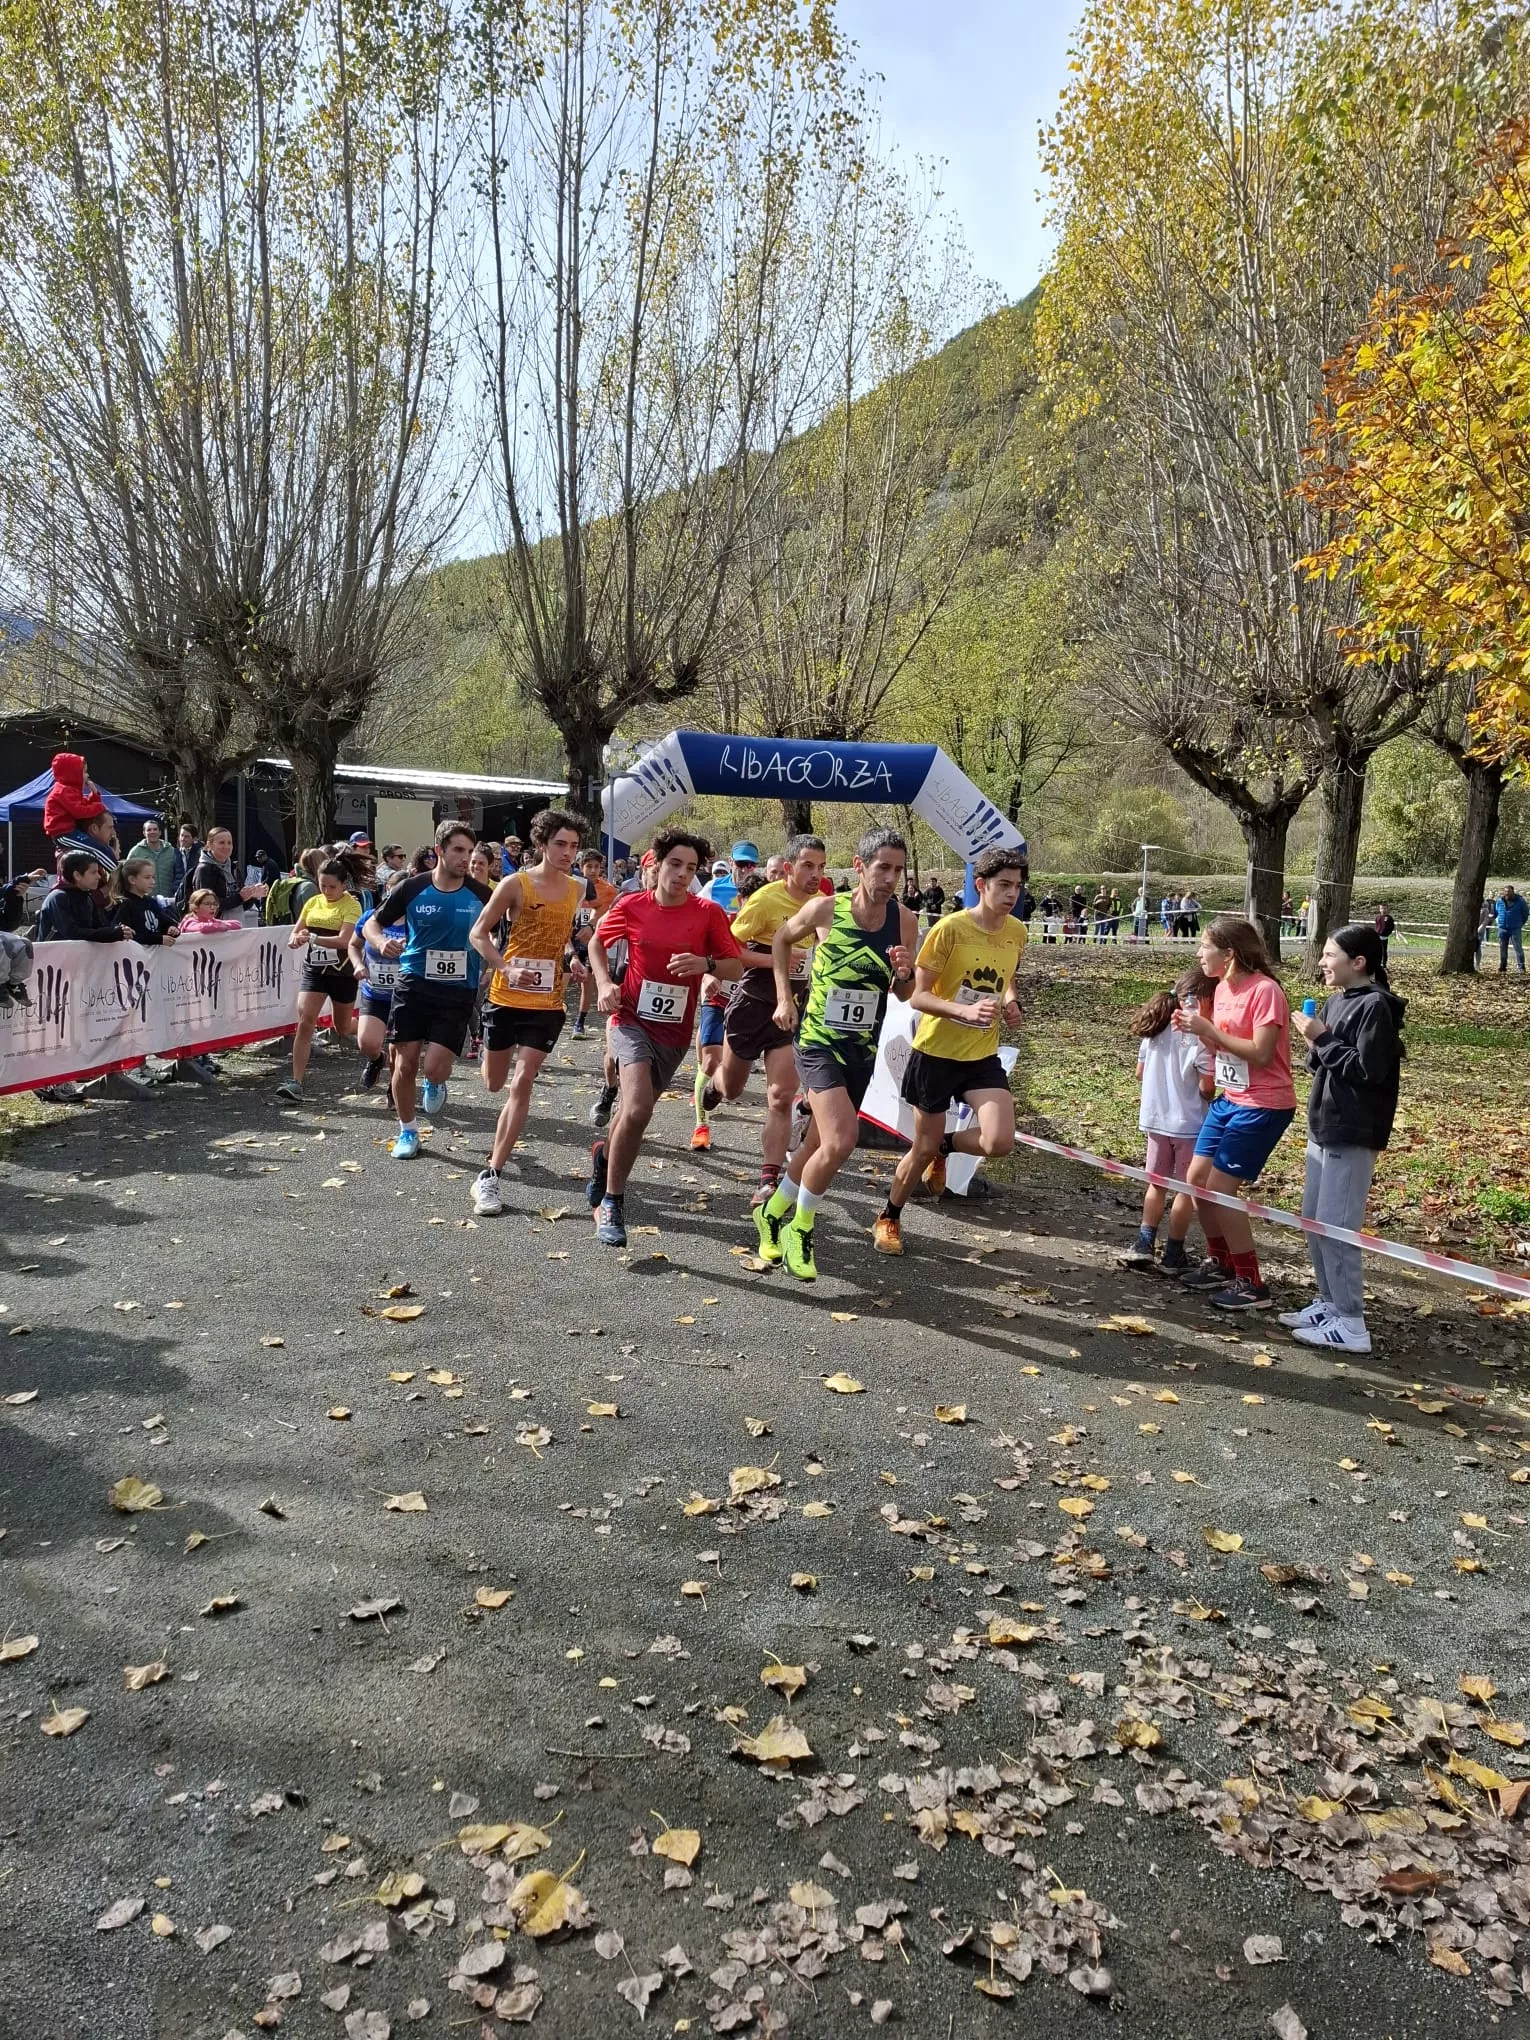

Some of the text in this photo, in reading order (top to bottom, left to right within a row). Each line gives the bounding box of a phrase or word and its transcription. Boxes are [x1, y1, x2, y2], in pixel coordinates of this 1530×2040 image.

[719, 744, 893, 793] RIBAGORZA
[437, 961, 456, 975] 98
[378, 973, 395, 985] 56
[651, 997, 675, 1015] 92
[840, 1003, 865, 1023] 19
[1222, 1065, 1238, 1083] 42
